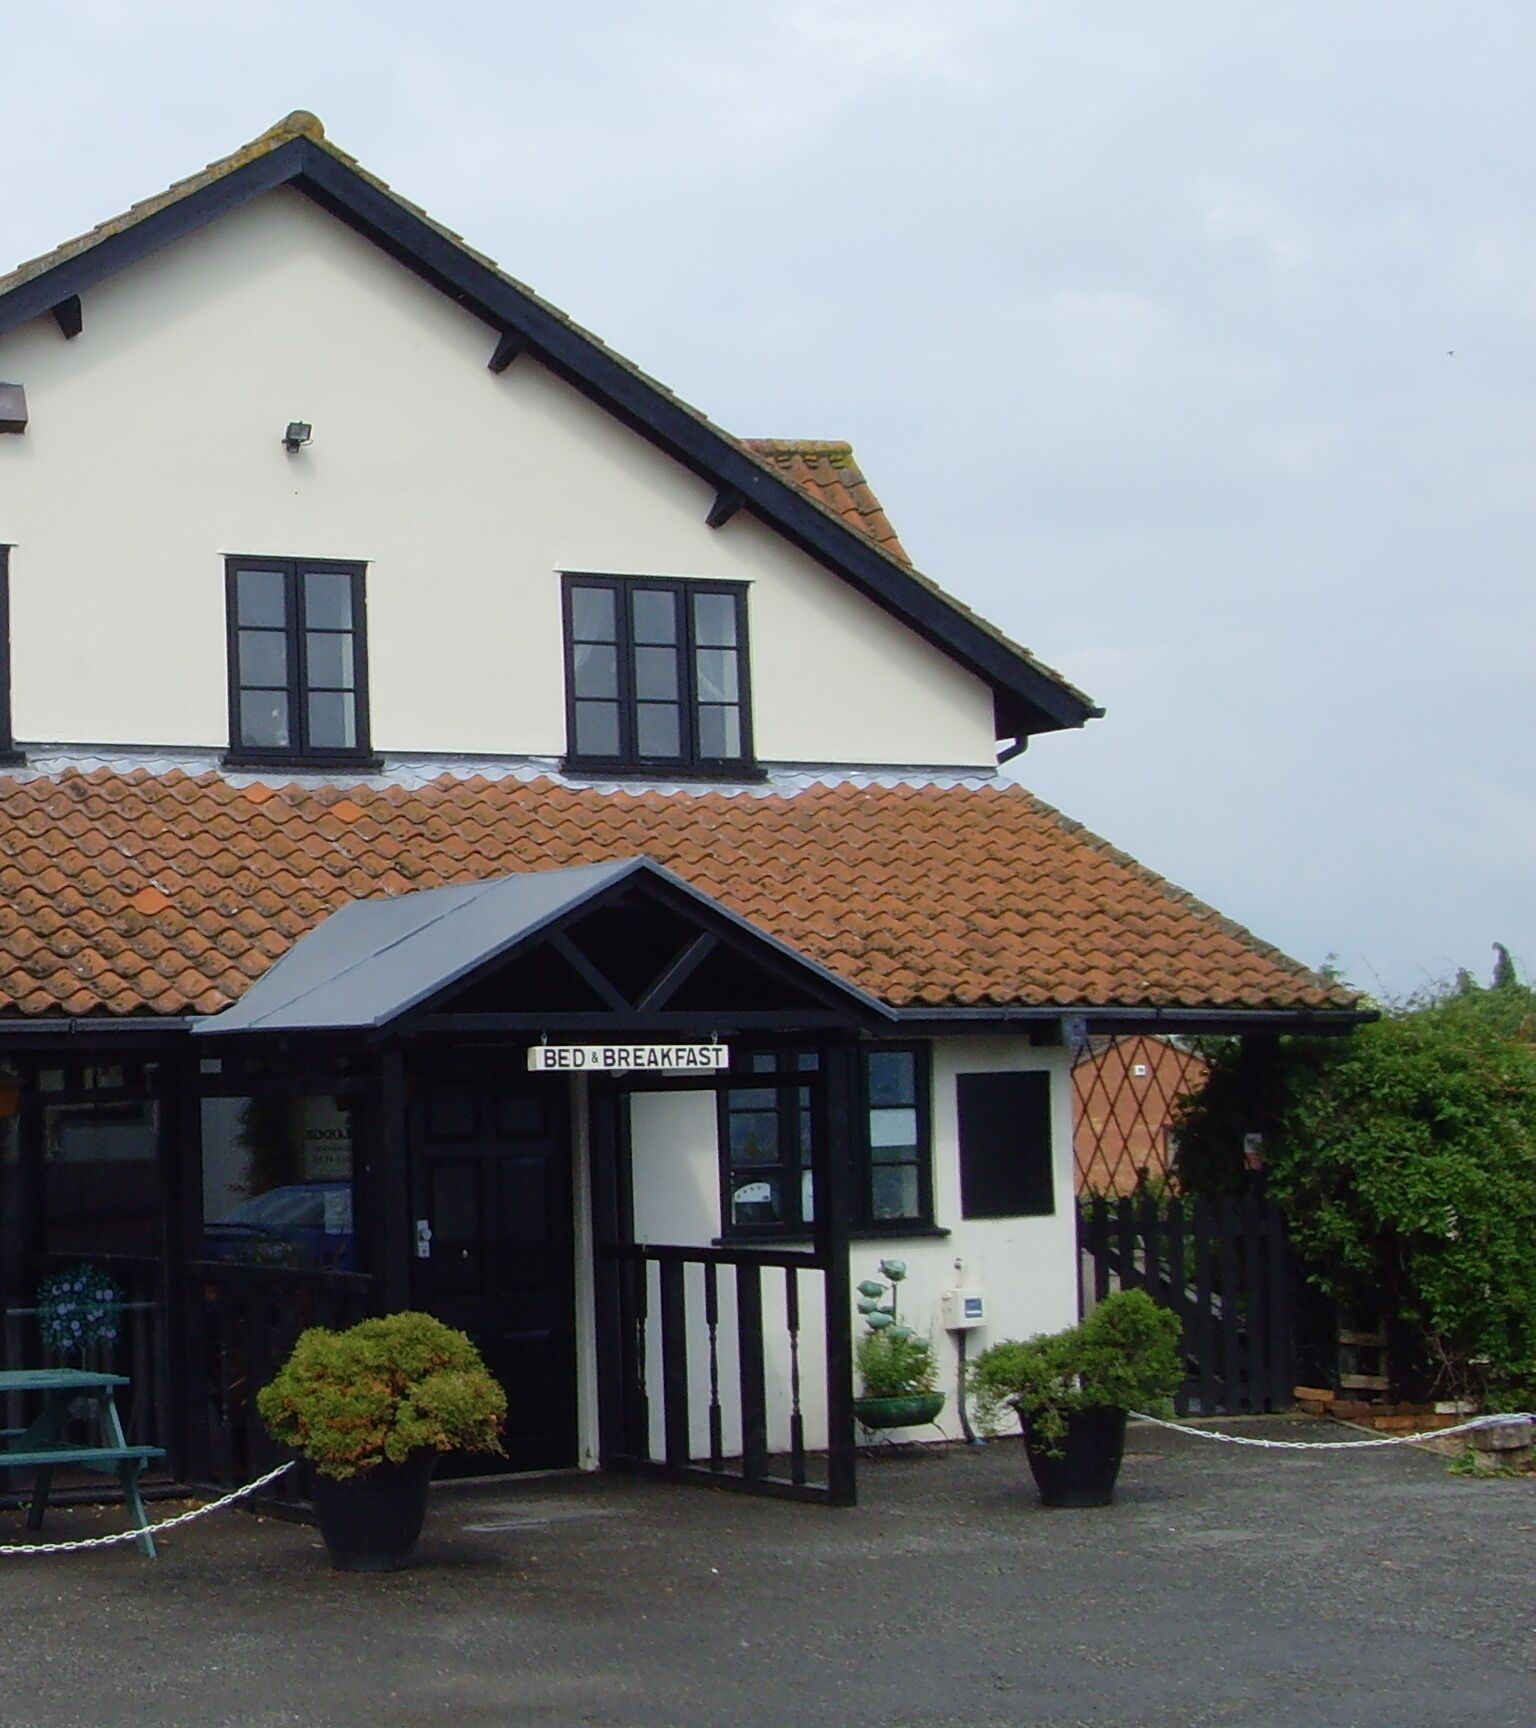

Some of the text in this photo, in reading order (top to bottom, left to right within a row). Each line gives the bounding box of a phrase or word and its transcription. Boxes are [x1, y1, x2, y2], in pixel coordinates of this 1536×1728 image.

[544, 1047, 722, 1068] BED & BREAKFAST
